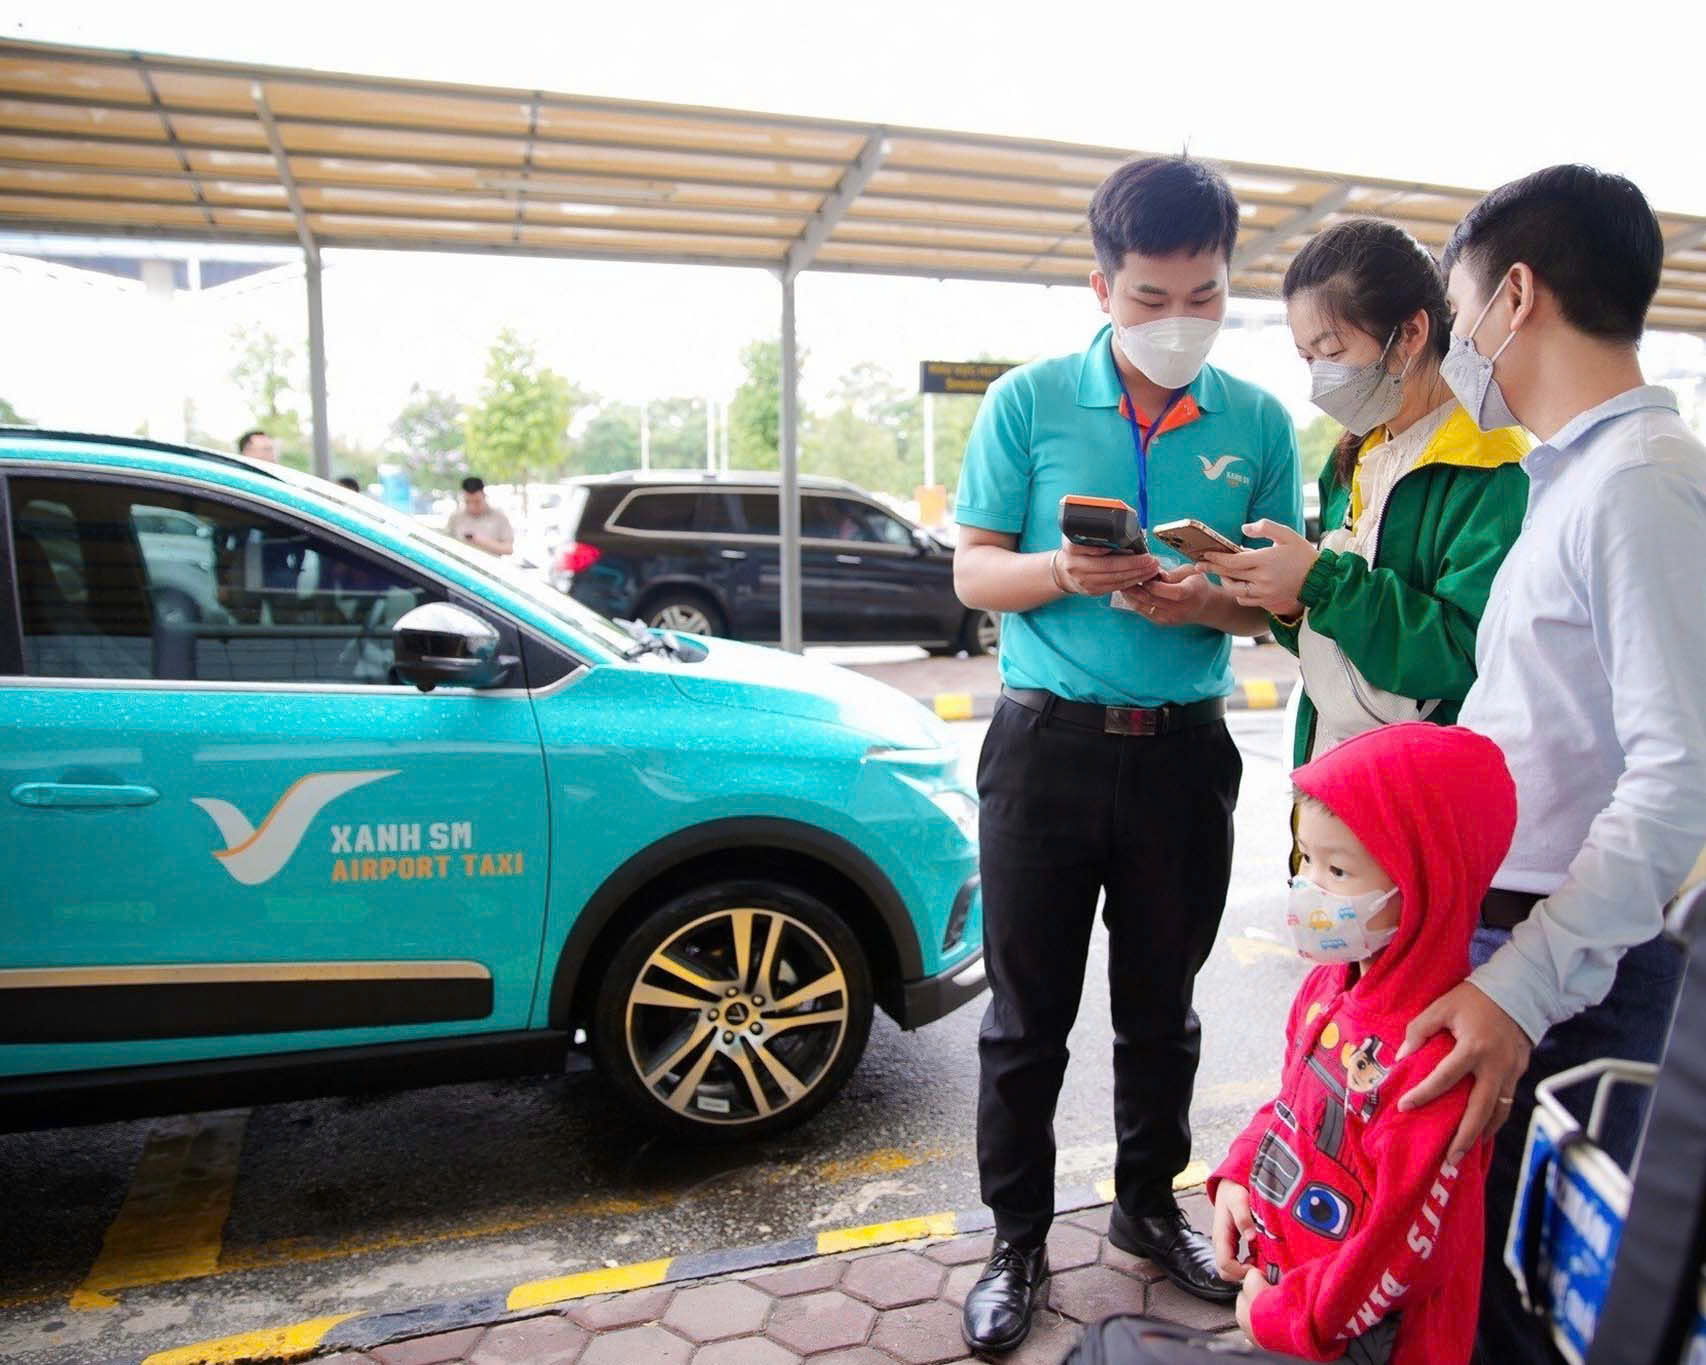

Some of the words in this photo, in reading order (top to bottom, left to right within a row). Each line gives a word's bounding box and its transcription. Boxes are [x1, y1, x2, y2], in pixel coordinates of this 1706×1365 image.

[331, 823, 421, 853] XANH
[430, 821, 472, 850] SM
[331, 856, 449, 882] AIRPORT
[463, 852, 524, 877] TAXI
